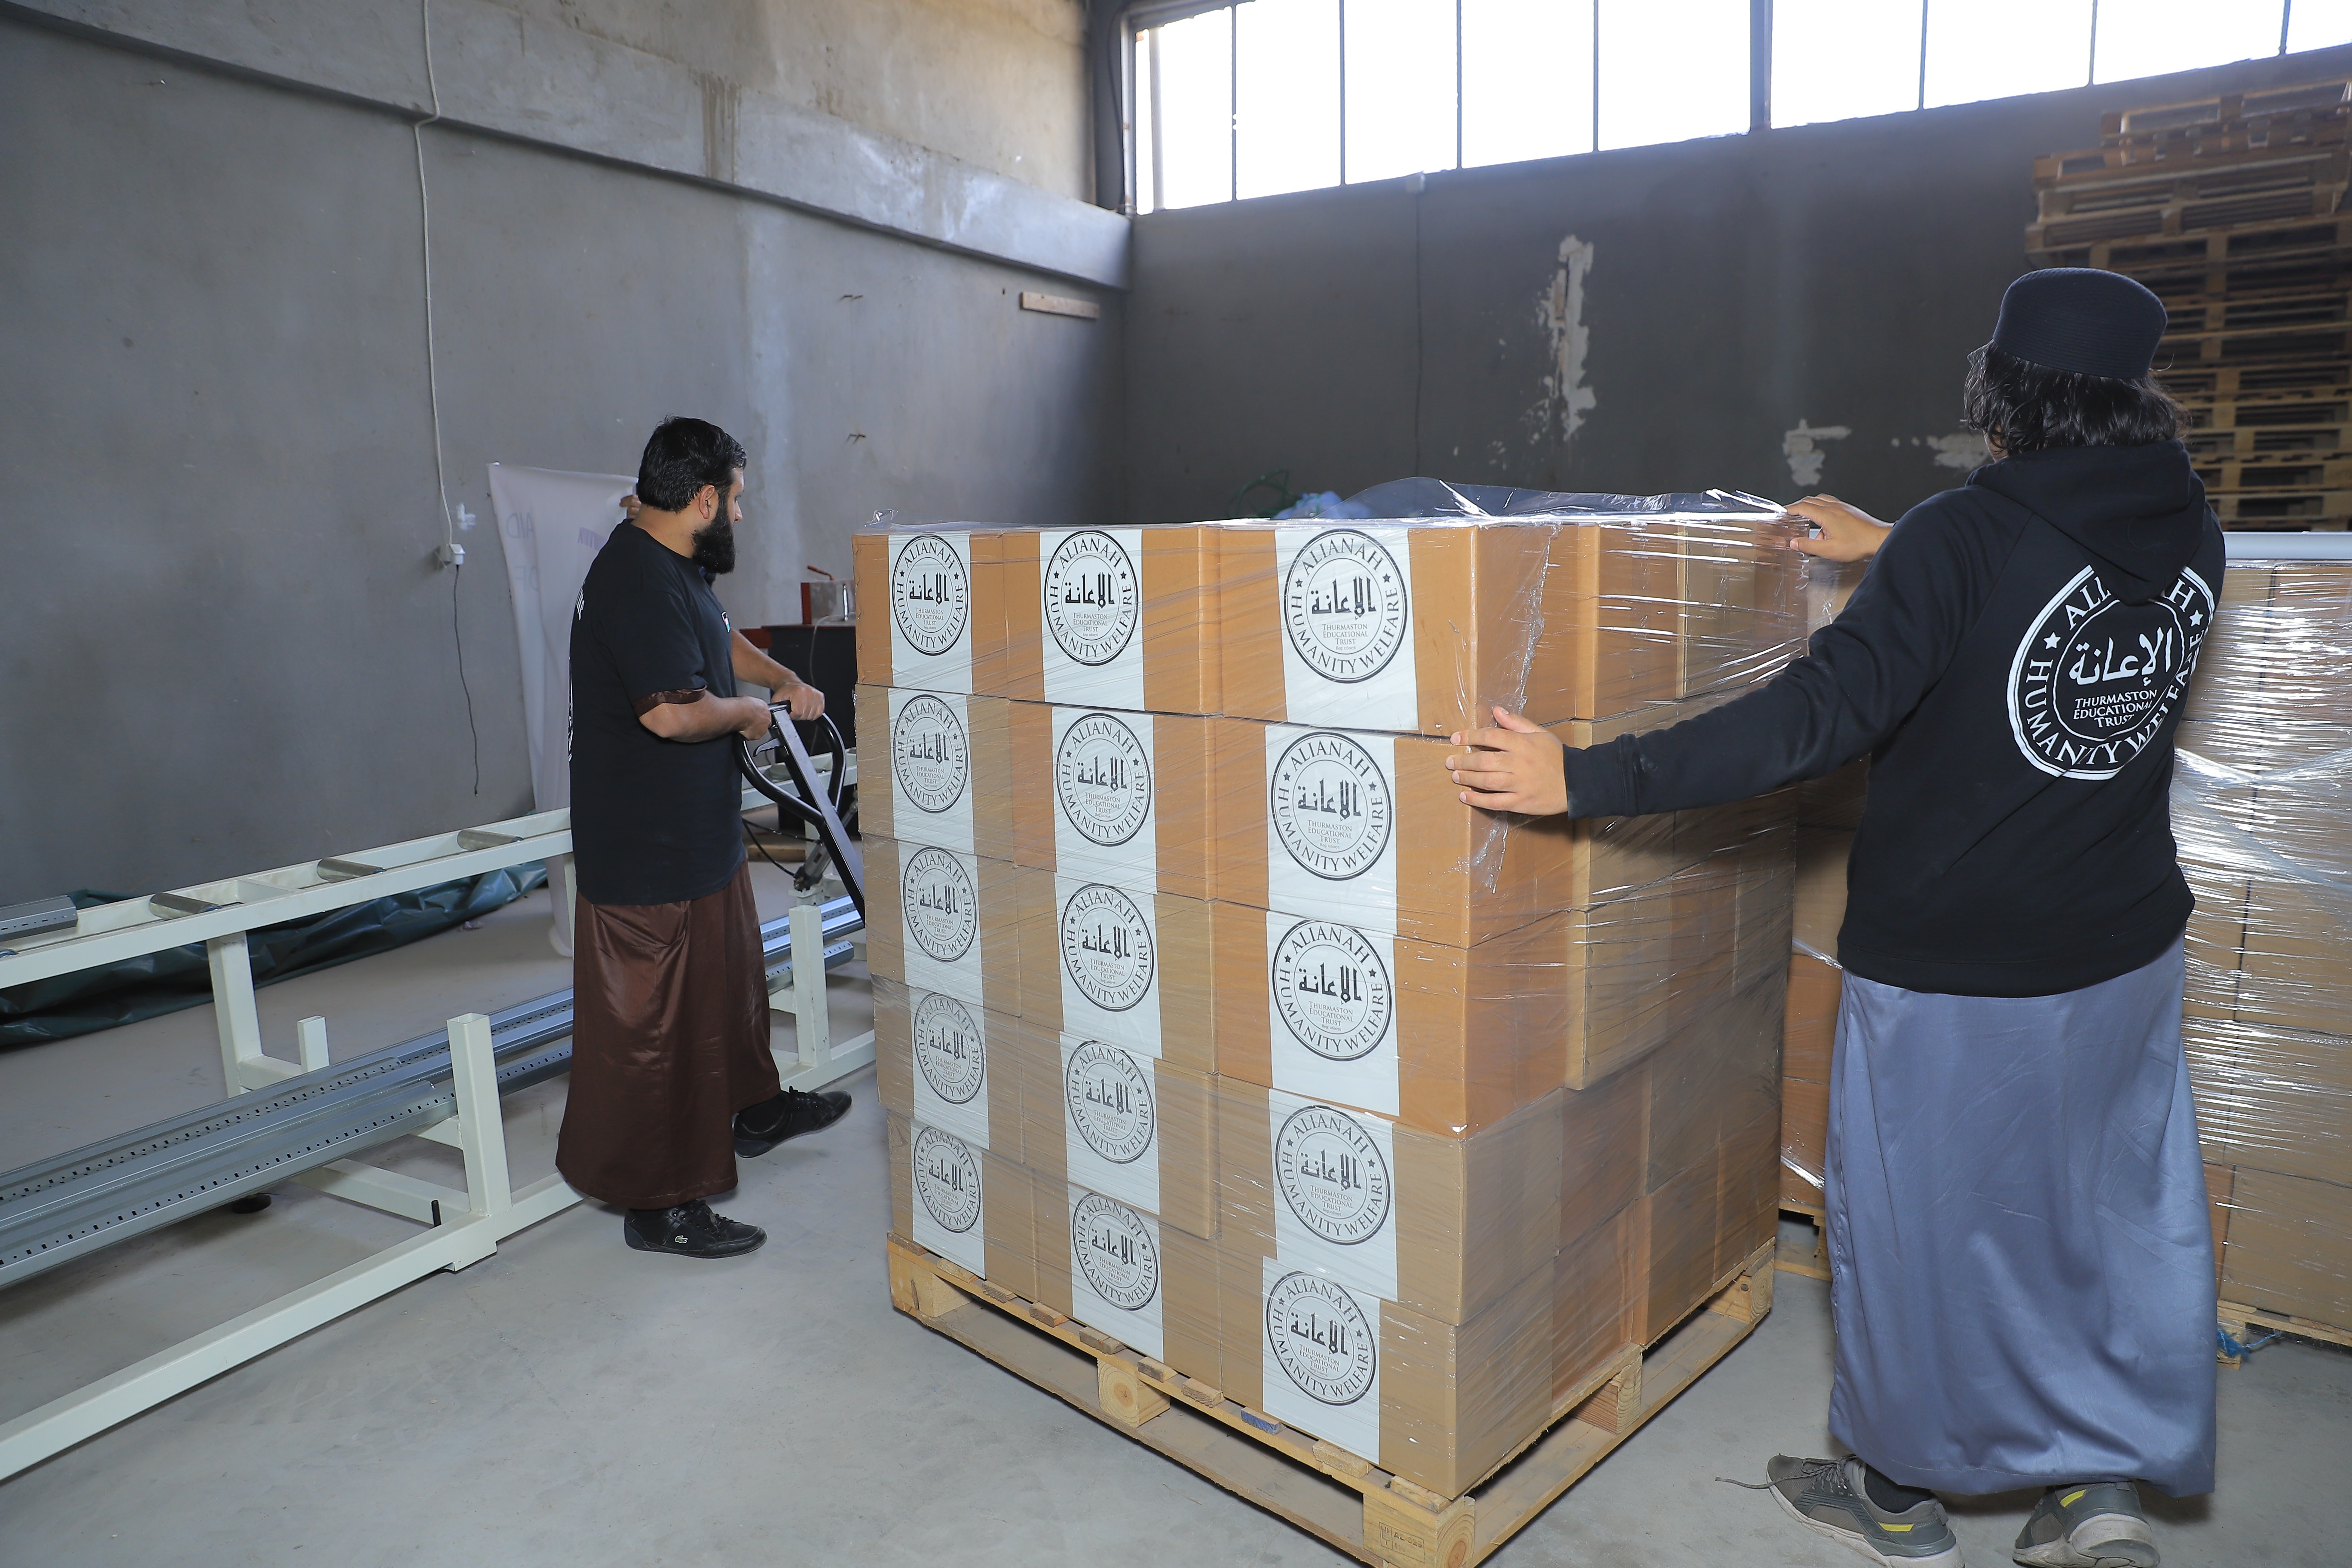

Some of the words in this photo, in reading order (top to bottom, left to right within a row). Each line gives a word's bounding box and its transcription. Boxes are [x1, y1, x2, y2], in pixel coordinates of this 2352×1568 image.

[904, 541, 955, 570] ALIANAH
[1059, 537, 1122, 569] ALIANAH
[1302, 537, 1384, 576] ALIANAH
[897, 583, 936, 648] HUMANITY
[937, 584, 963, 645] WELFARE
[2066, 576, 2196, 631] ALIH
[1050, 586, 1098, 657] HUMANITY
[1100, 584, 1132, 654] WELFARE
[1292, 596, 1356, 673] HUMANITY
[1359, 588, 1399, 669] WELFARE
[2069, 626, 2172, 686] الإعانة
[2073, 700, 2153, 720] EDUCATIONAL
[2075, 689, 2157, 709] THURMASTON
[904, 701, 954, 730] ALIANAH
[2094, 714, 2135, 727] TRUST
[1071, 721, 1135, 755] ALIANAH
[898, 741, 937, 805] HUMANITY
[939, 744, 962, 804] WELFARE
[1290, 740, 1371, 778] ALIANAH
[1062, 763, 1110, 838] HUMANITY
[1112, 772, 1144, 836] WELFARE
[1085, 792, 1120, 803] THURMASTON
[1086, 798, 1121, 809] EDUCATIONAL
[1095, 806, 1111, 814] TRUST
[1278, 787, 1339, 871] HUMANITY
[1342, 797, 1383, 869] WELFARE
[1307, 819, 1352, 832] THURMASTON
[1308, 826, 1352, 839] EDUCATIONAL
[1320, 835, 1340, 844] TRUST
[914, 853, 963, 884] ALIANAH
[908, 888, 946, 955] HUMANITY
[948, 899, 971, 954] WELFARE
[1075, 891, 1136, 925] ALIANAH
[1291, 926, 1370, 964] ALIANAH
[1067, 929, 1115, 1003] HUMANITY
[1117, 941, 1147, 1002] WELFARE
[1090, 958, 1124, 970] THURMASTON
[1090, 964, 1125, 977] EDUCATIONAL
[1099, 972, 1115, 981] TRUST
[924, 998, 971, 1031] ALIANAH
[1280, 968, 1341, 1052] HUMANITY
[1344, 983, 1383, 1051] WELFARE
[1309, 1001, 1353, 1015] THURMASTON
[1309, 1008, 1354, 1022] EDUCATIONAL
[1321, 1017, 1341, 1027] TRUST
[918, 1028, 954, 1097] HUMANITY
[956, 1046, 979, 1097] WELFARE
[1079, 1046, 1138, 1083] ALIANAH
[1072, 1080, 1117, 1155] HUMANITY
[1119, 1099, 1148, 1155] WELFARE
[1093, 1109, 1126, 1125] THURMASTON
[1094, 1115, 1126, 1131] EDUCATIONAL
[1102, 1124, 1118, 1134] TRUST
[1293, 1114, 1369, 1155] ALIANAH
[918, 1155, 952, 1225] HUMANITY
[953, 1181, 976, 1226] WELFARE
[1282, 1151, 1341, 1236] HUMANITY
[1344, 1173, 1382, 1236] WELFARE
[1310, 1184, 1353, 1202] THURMASTON
[1311, 1191, 1354, 1209] EDUCATIONAL
[1322, 1200, 1342, 1212] TRUST
[1086, 1199, 1142, 1238] ALIANAH
[1078, 1225, 1122, 1302] HUMANITY
[1124, 1254, 1152, 1303] WELFARE
[1285, 1279, 1358, 1323] ALIANAH
[1273, 1308, 1327, 1395] HUMANITY
[1330, 1342, 1368, 1397] WELFARE
[1299, 1343, 1340, 1366] THURMASTON
[1299, 1350, 1340, 1373] EDUCATIONAL
[1310, 1360, 1328, 1374] TRUST
